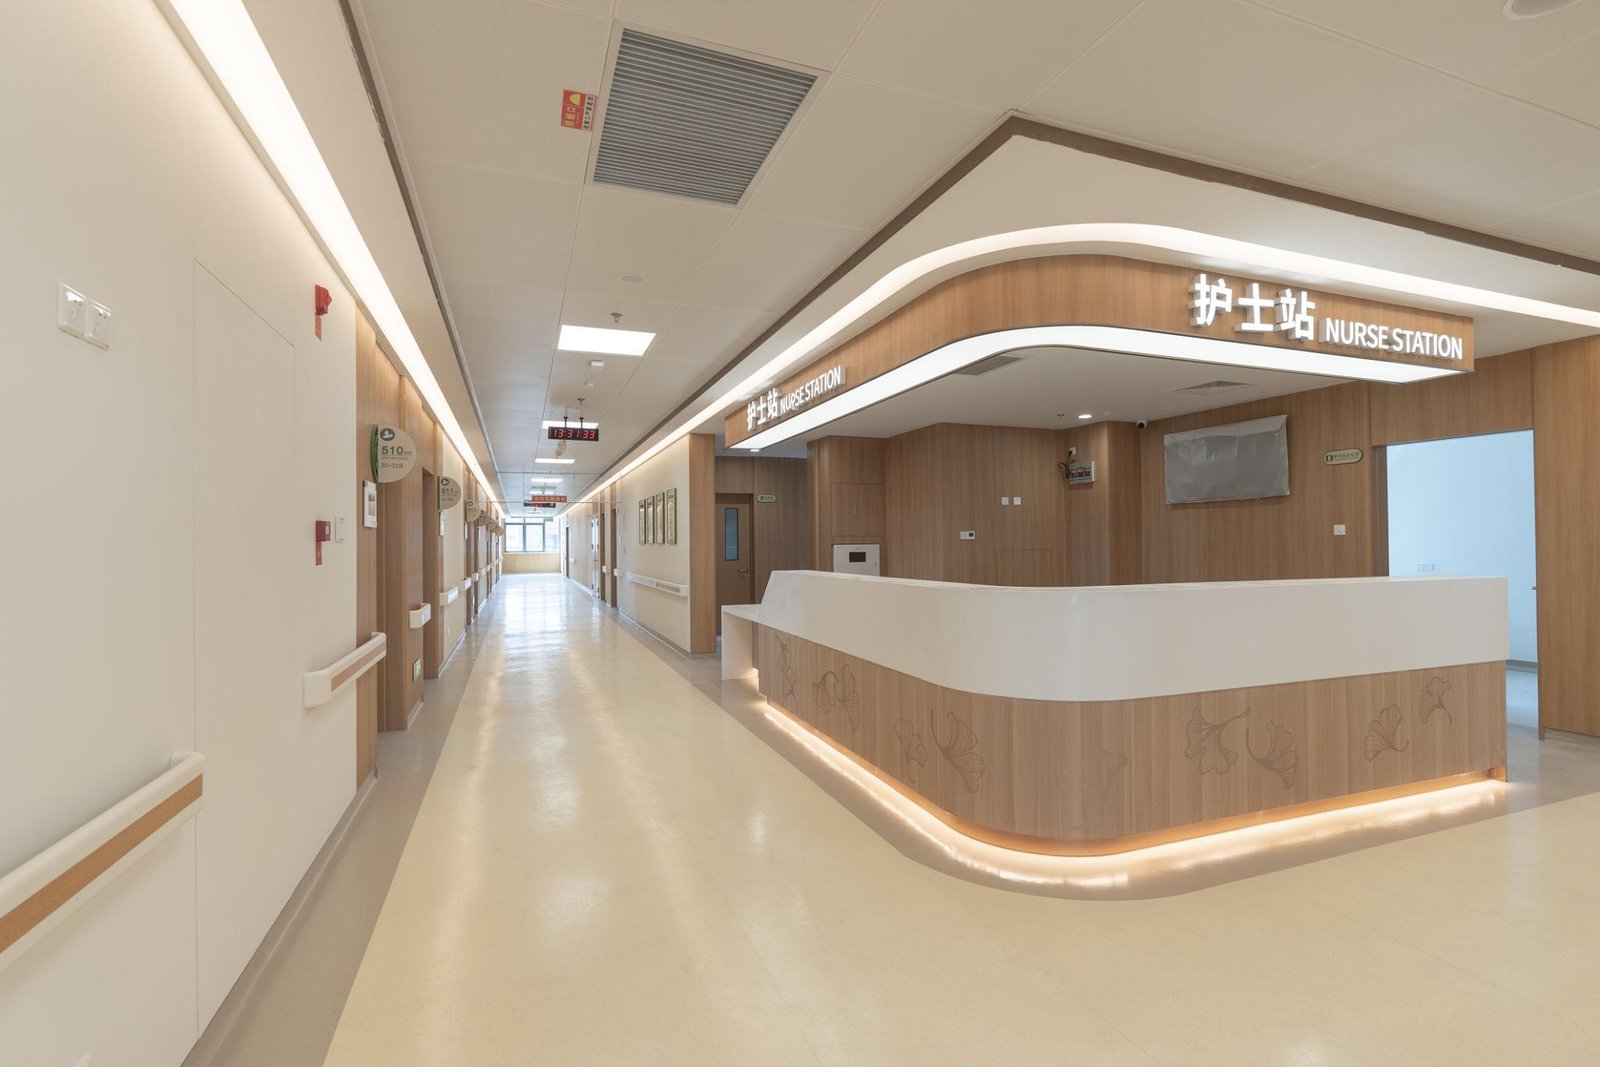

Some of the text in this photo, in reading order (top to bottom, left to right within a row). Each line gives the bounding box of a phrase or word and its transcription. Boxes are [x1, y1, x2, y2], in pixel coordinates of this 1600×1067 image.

[1192, 273, 1463, 360] 护士站 NURSE STATION
[747, 365, 841, 432] 护士站 NURSE STATION
[381, 445, 404, 455] 510
[553, 429, 596, 439] 13:31:33
